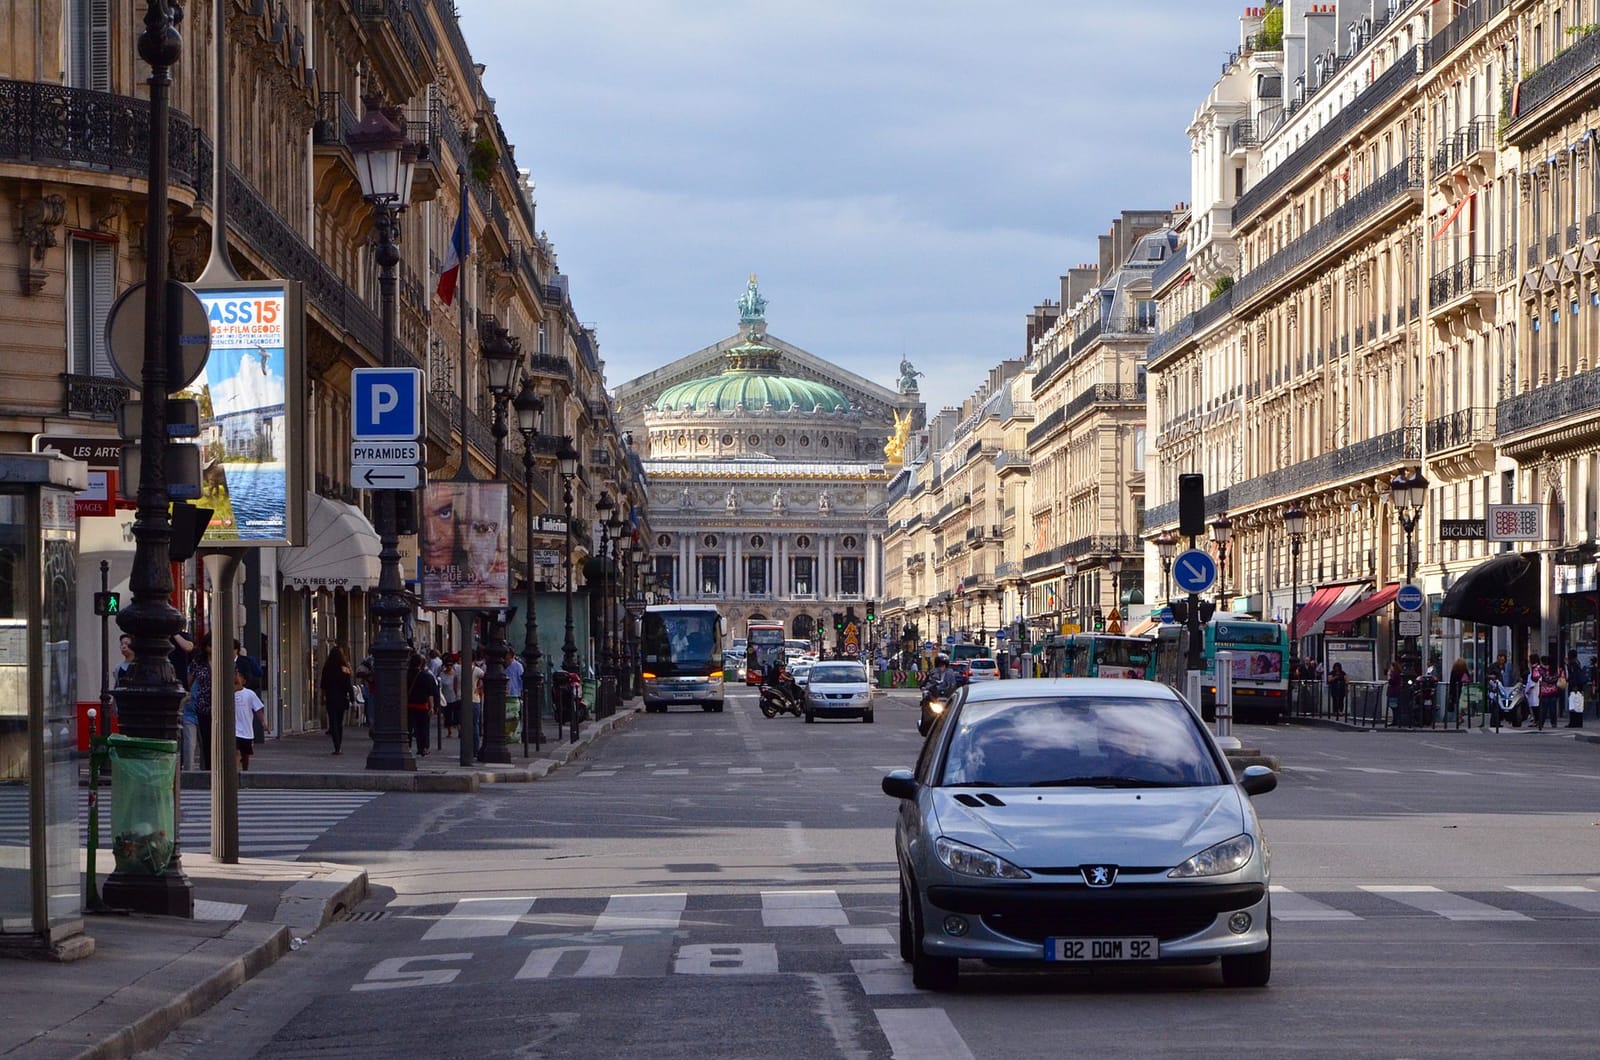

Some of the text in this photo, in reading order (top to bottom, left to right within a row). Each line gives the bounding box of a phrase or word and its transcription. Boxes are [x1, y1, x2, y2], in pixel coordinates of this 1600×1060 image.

[230, 325, 250, 333] FILM
[371, 384, 399, 425] P
[73, 446, 91, 457] LES
[354, 448, 416, 459] PYRAMIDES
[1442, 526, 1485, 537] BIGUINE
[424, 565, 437, 573] LA
[440, 565, 462, 573] PIEL
[293, 577, 349, 585] TAX FREE SHOP
[440, 573, 462, 581] QUE
[1064, 941, 1151, 959] 82 DQM 92
[349, 942, 780, 992] BUS
